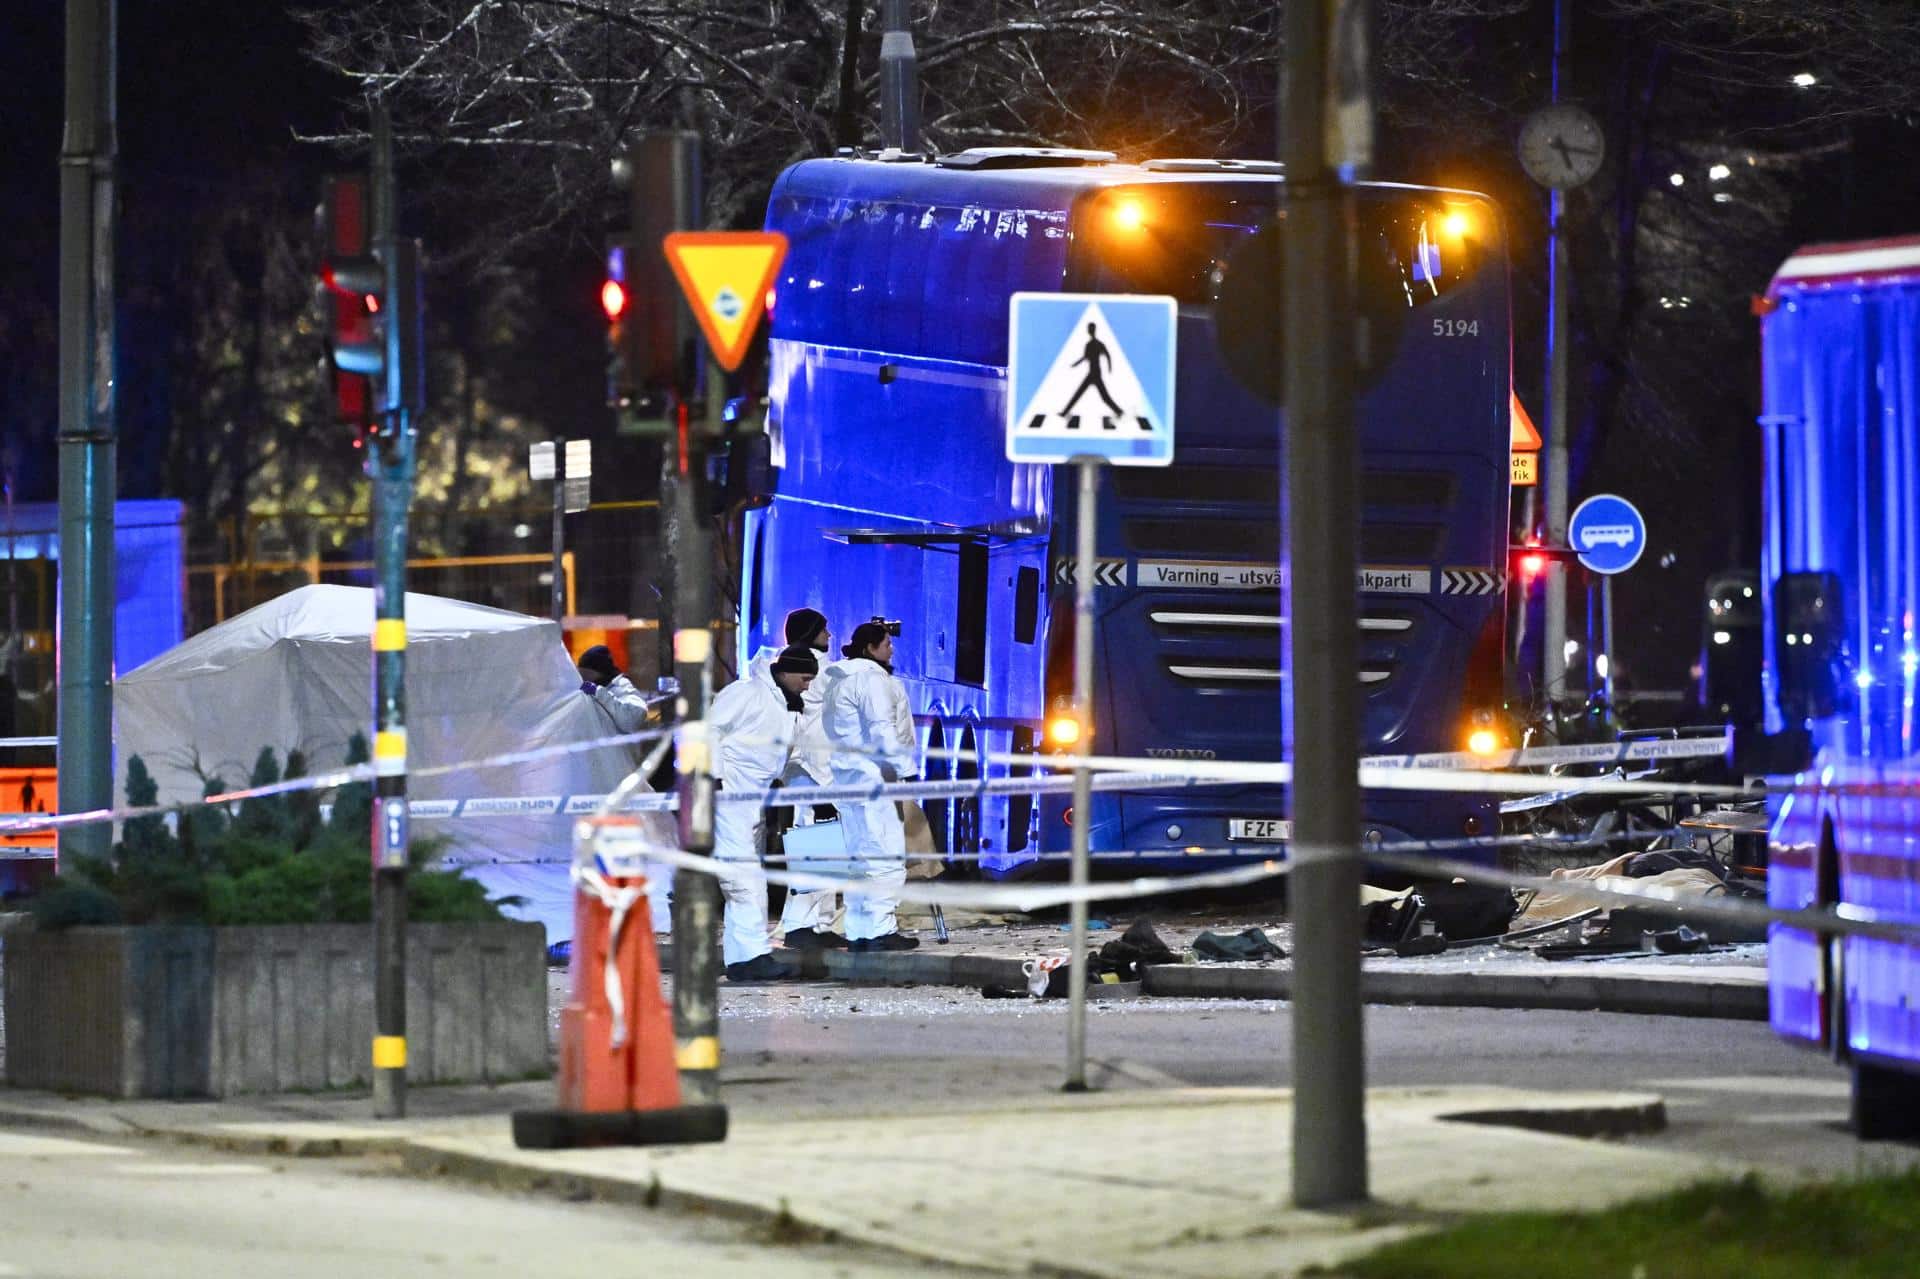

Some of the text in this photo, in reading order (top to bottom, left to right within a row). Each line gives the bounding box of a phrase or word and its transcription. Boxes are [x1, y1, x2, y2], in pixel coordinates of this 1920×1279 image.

[1433, 319, 1479, 336] 5194
[1512, 457, 1527, 467] de
[1513, 470, 1529, 480] fik
[1157, 567, 1219, 585] Varning
[1240, 569, 1282, 584] utsvä
[1357, 572, 1411, 589] akparti
[1244, 821, 1276, 836] FZF
